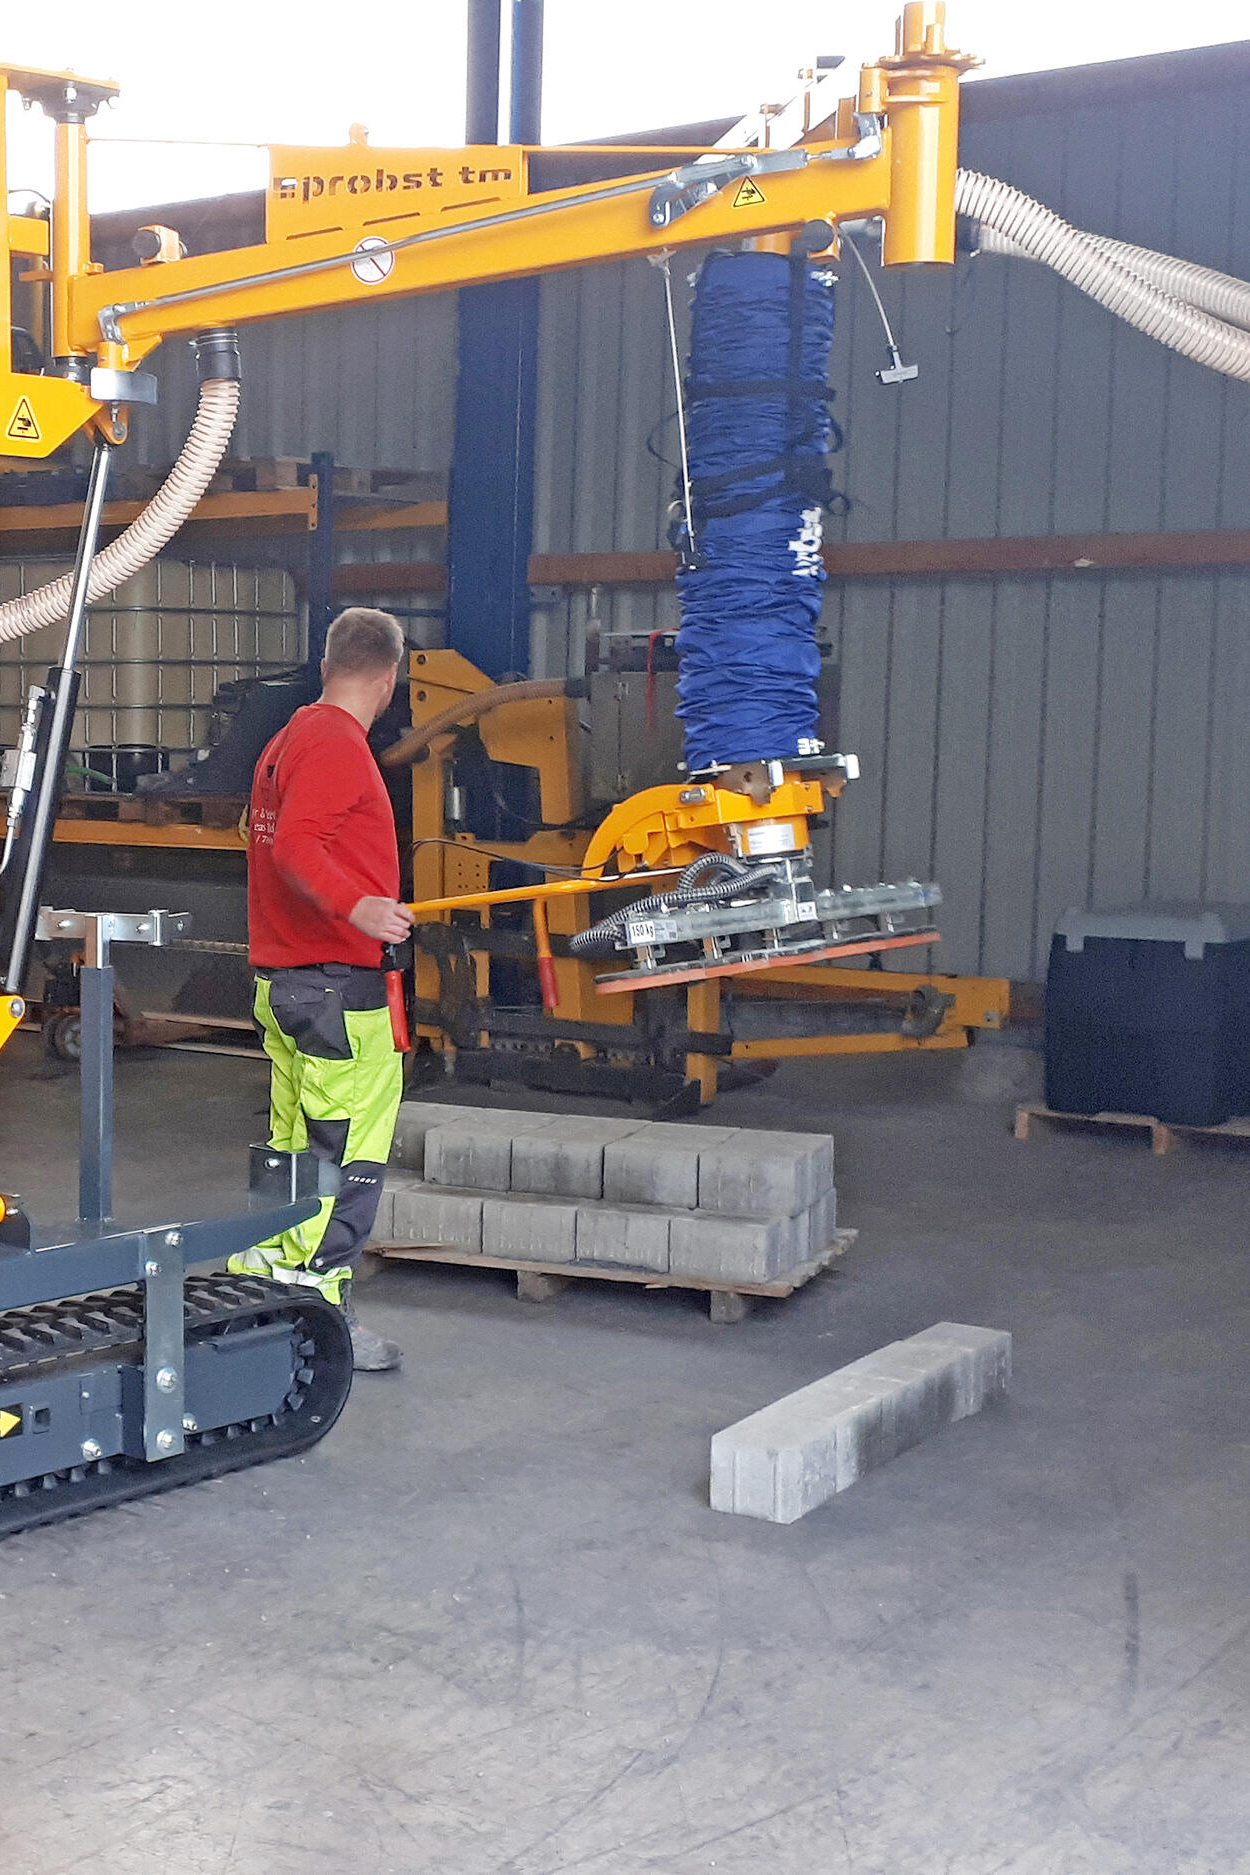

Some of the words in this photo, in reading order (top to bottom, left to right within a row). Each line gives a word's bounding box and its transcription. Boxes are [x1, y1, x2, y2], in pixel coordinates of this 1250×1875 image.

[302, 168, 444, 204] probst
[459, 166, 512, 185] tm
[631, 924, 645, 937] 150
[646, 923, 654, 938] kg
